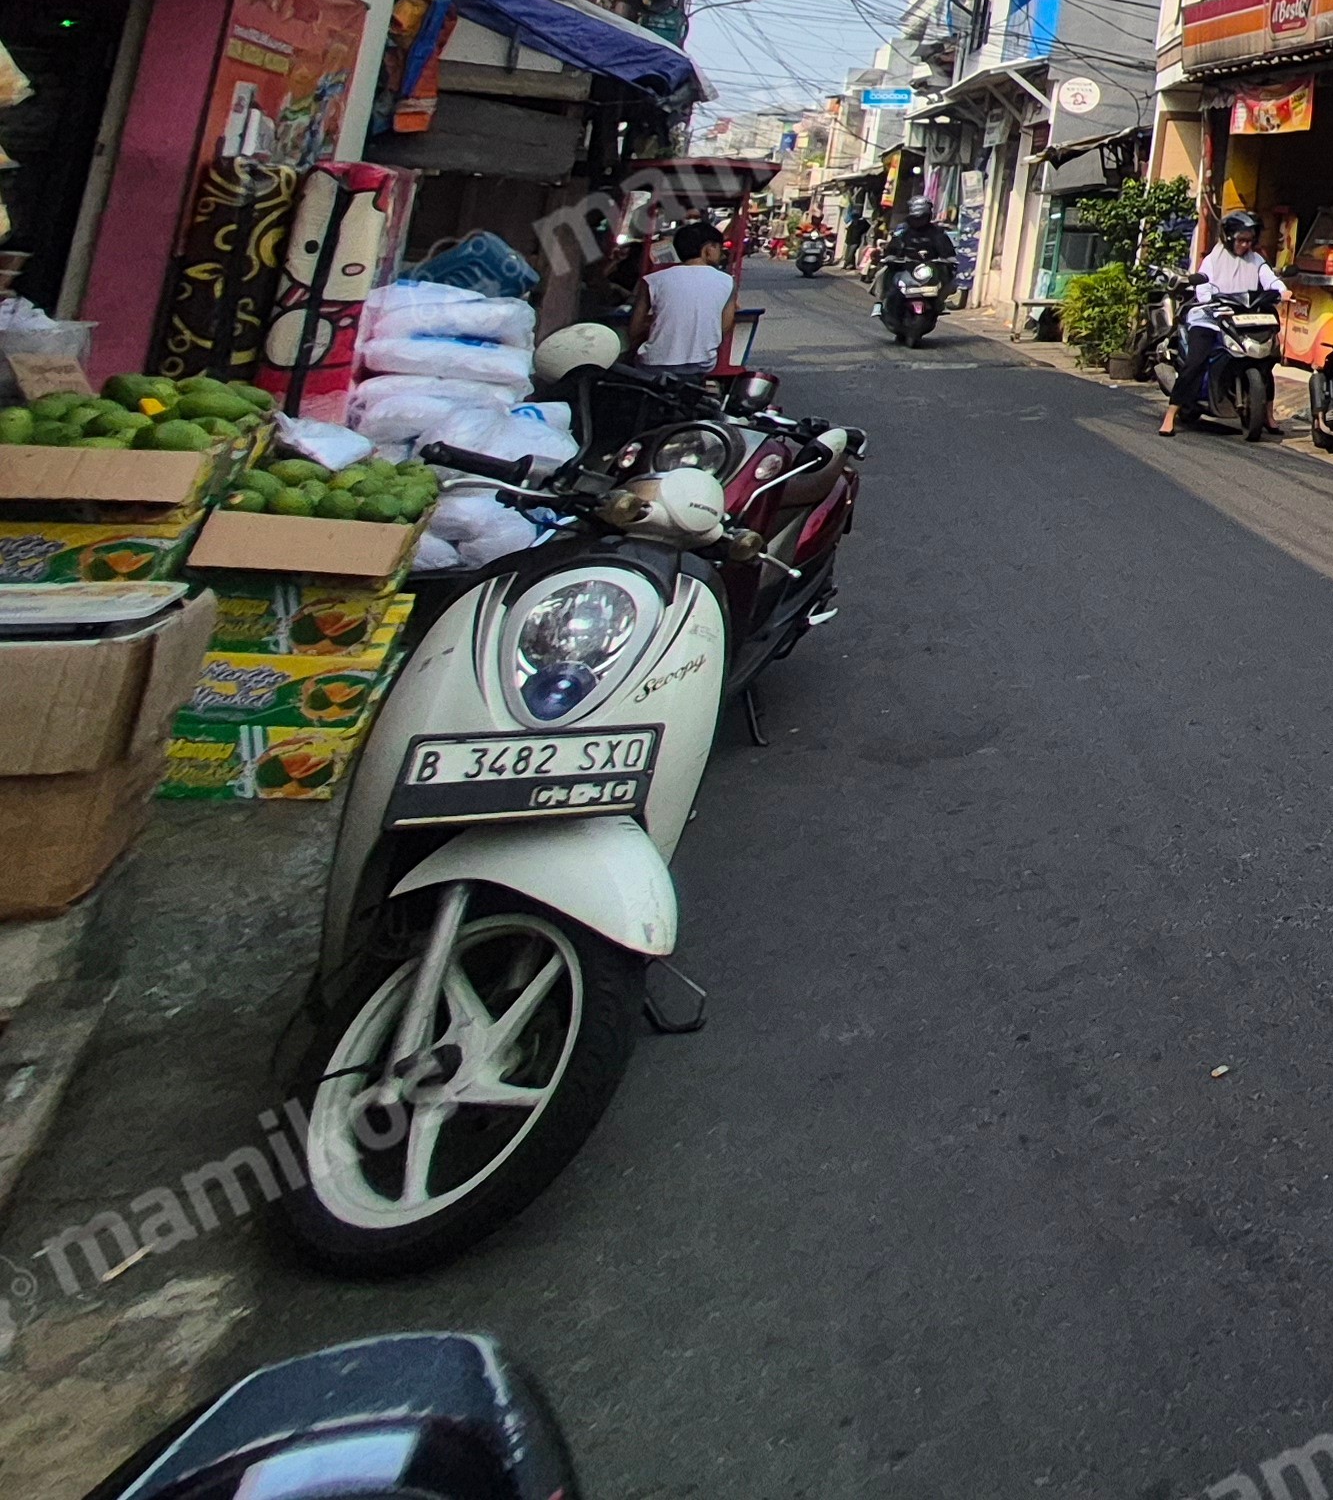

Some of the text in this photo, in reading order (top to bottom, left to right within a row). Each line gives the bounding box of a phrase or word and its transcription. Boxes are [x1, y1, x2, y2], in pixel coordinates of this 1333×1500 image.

[634, 652, 707, 704] Scoopy
[416, 750, 441, 782] B
[463, 743, 558, 779] 3482
